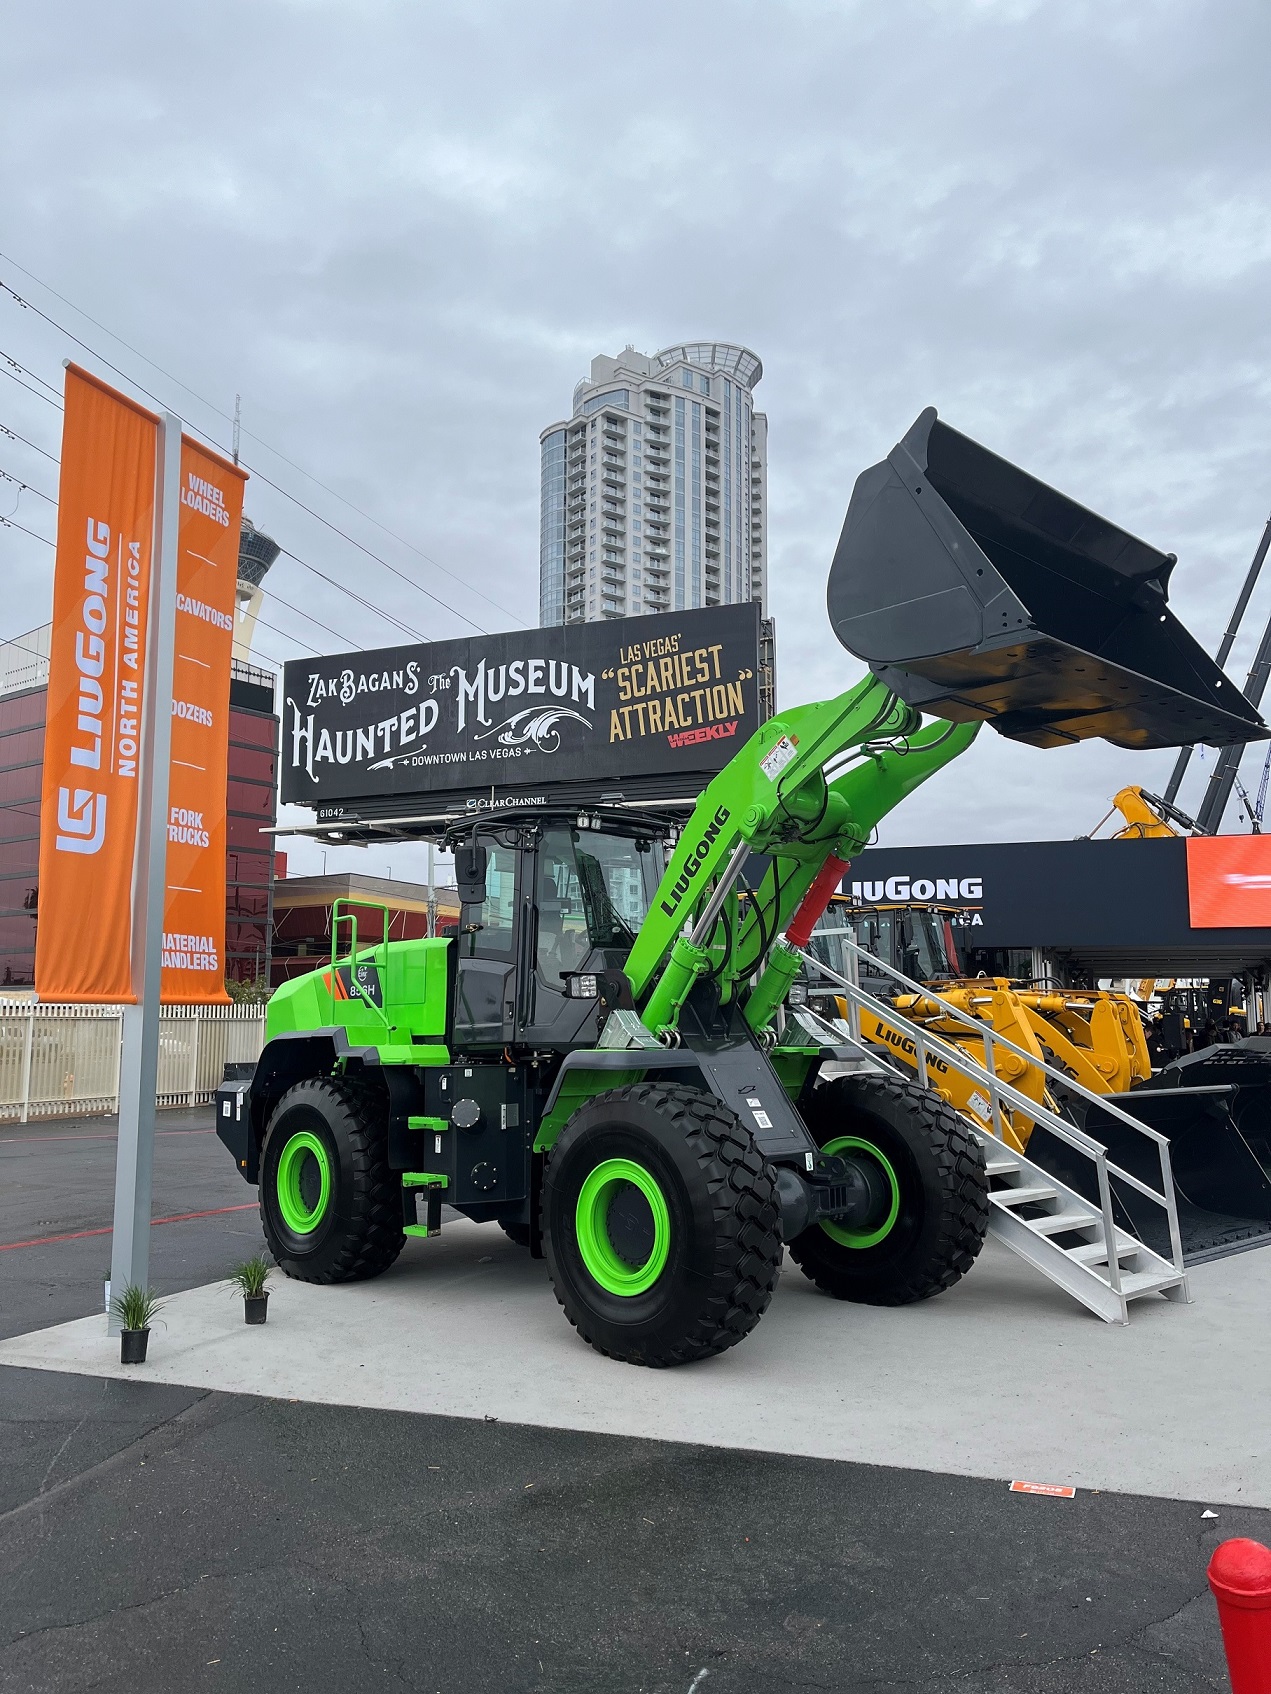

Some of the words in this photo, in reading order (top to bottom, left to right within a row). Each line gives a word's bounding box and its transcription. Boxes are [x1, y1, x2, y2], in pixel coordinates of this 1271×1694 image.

[181, 487, 230, 527] LOADERS
[188, 472, 225, 507] WHEEL
[123, 541, 141, 670] AMERICA
[175, 591, 233, 631] CAVATORS
[619, 645, 641, 665] LAS
[306, 673, 338, 707] ZAK
[428, 672, 451, 694] The
[118, 680, 139, 777] NORTH
[287, 697, 439, 783] HAUNTED
[450, 657, 596, 734] MUSEUM
[667, 720, 738, 749] WEEKLY
[411, 752, 467, 766] DOWNTOWN
[469, 750, 488, 761] LAS
[490, 747, 522, 759] VEGAS
[171, 806, 203, 829] FORK
[319, 808, 344, 818] 61042
[874, 1022, 949, 1074] LIUGNG
